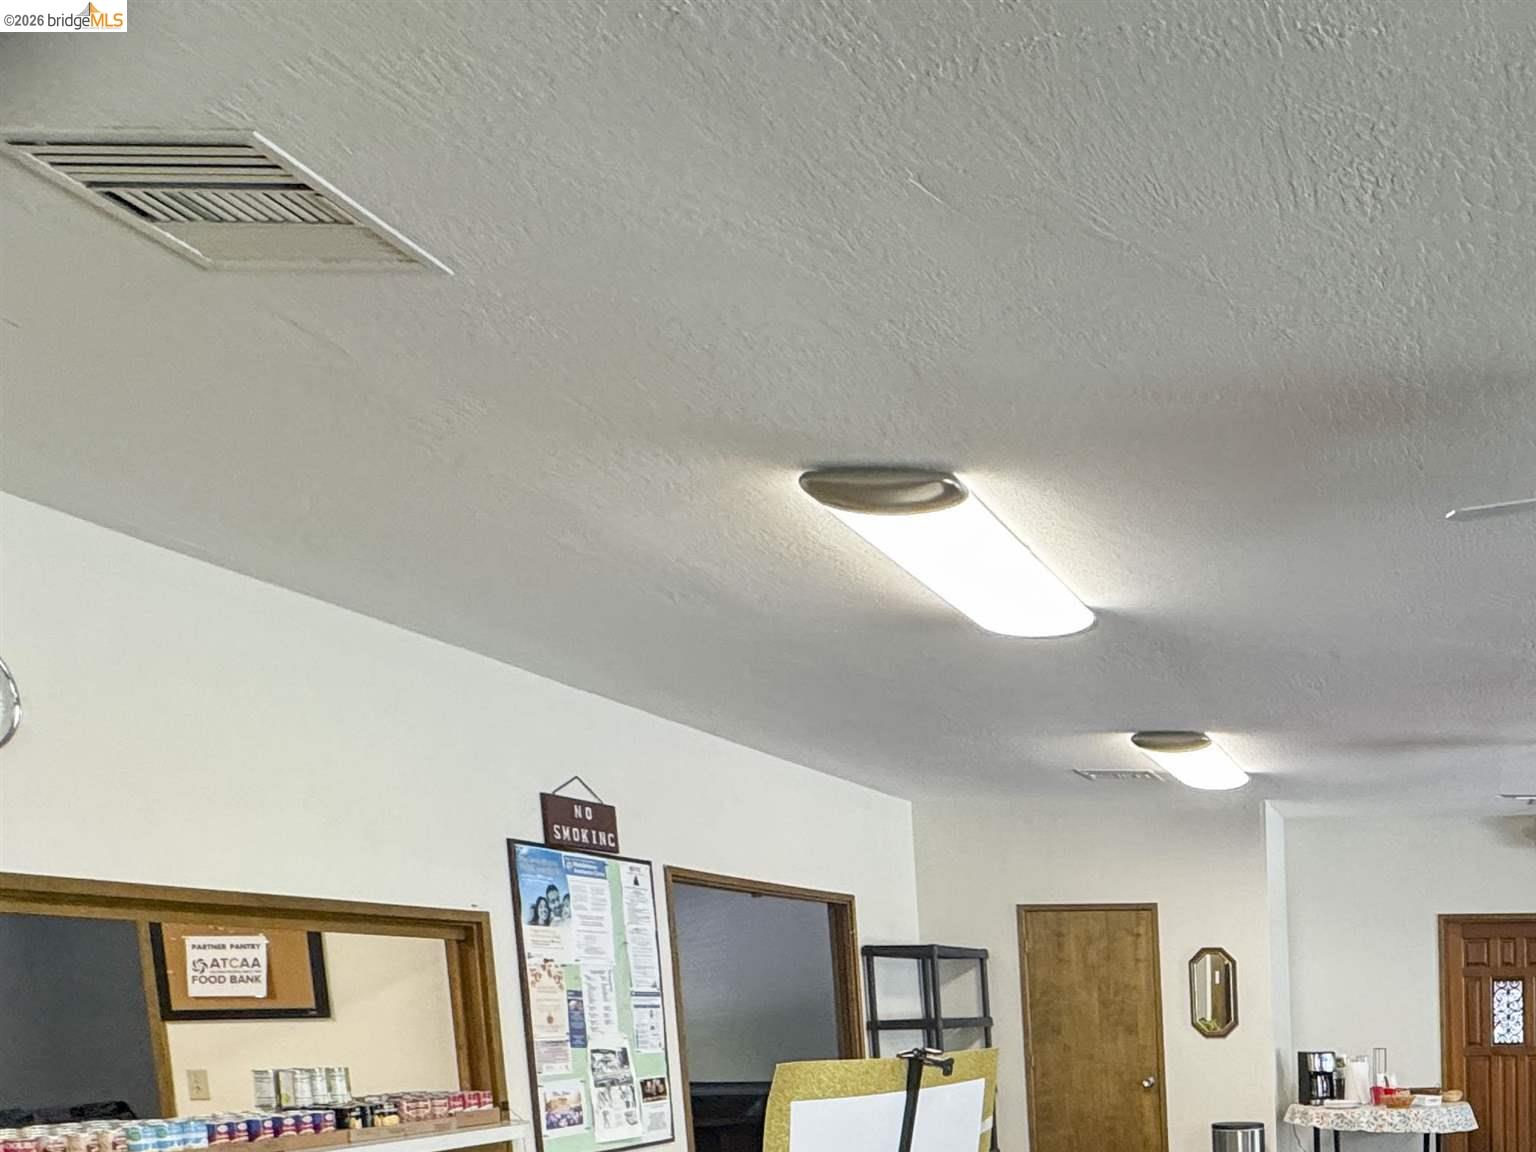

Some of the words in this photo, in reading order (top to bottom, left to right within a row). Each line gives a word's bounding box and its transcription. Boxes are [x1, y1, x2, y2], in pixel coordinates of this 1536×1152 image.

[573, 804, 593, 820] NO
[552, 824, 616, 847] SMOKING
[209, 957, 262, 969] ATCAA
[191, 975, 227, 985] FOOD
[229, 975, 262, 985] BANK
